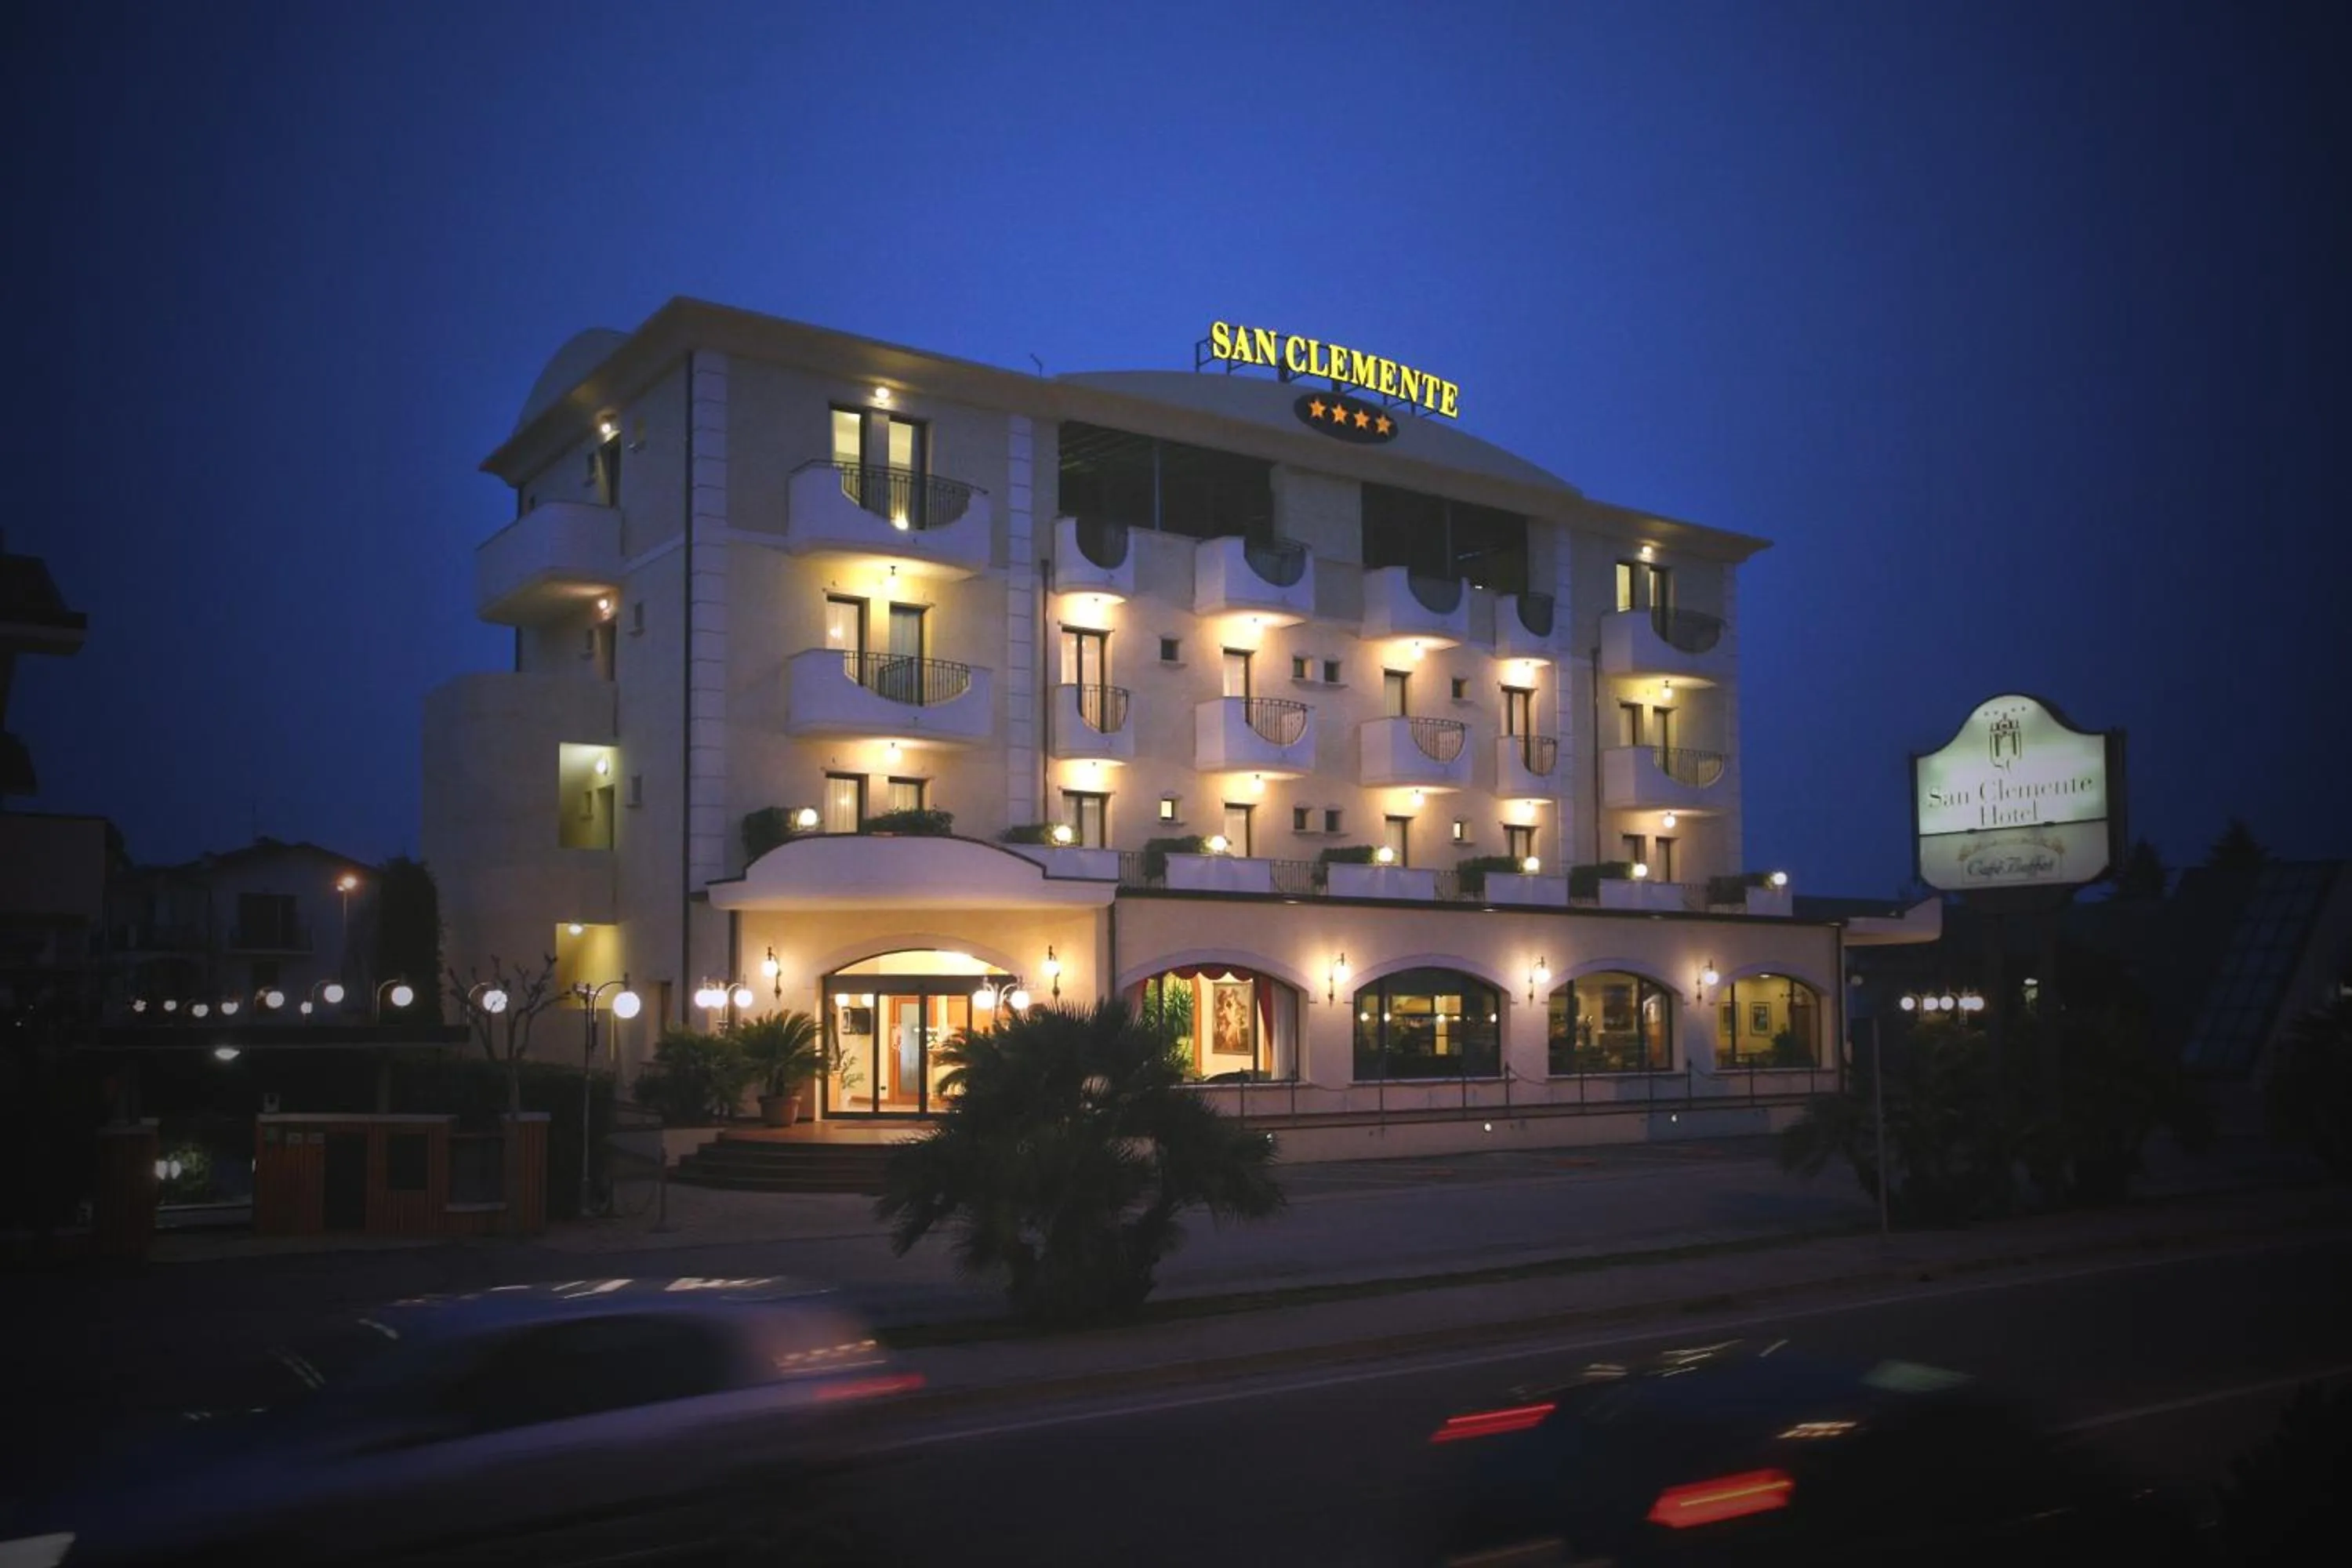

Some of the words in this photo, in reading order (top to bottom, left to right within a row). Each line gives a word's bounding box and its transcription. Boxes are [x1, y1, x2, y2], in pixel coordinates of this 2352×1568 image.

[1210, 321, 1277, 367] SAN
[1284, 335, 1460, 419] CLEMENTE
[1928, 785, 1970, 809] San
[1979, 776, 2094, 805] Clemente
[1980, 799, 2039, 826] Hotel
